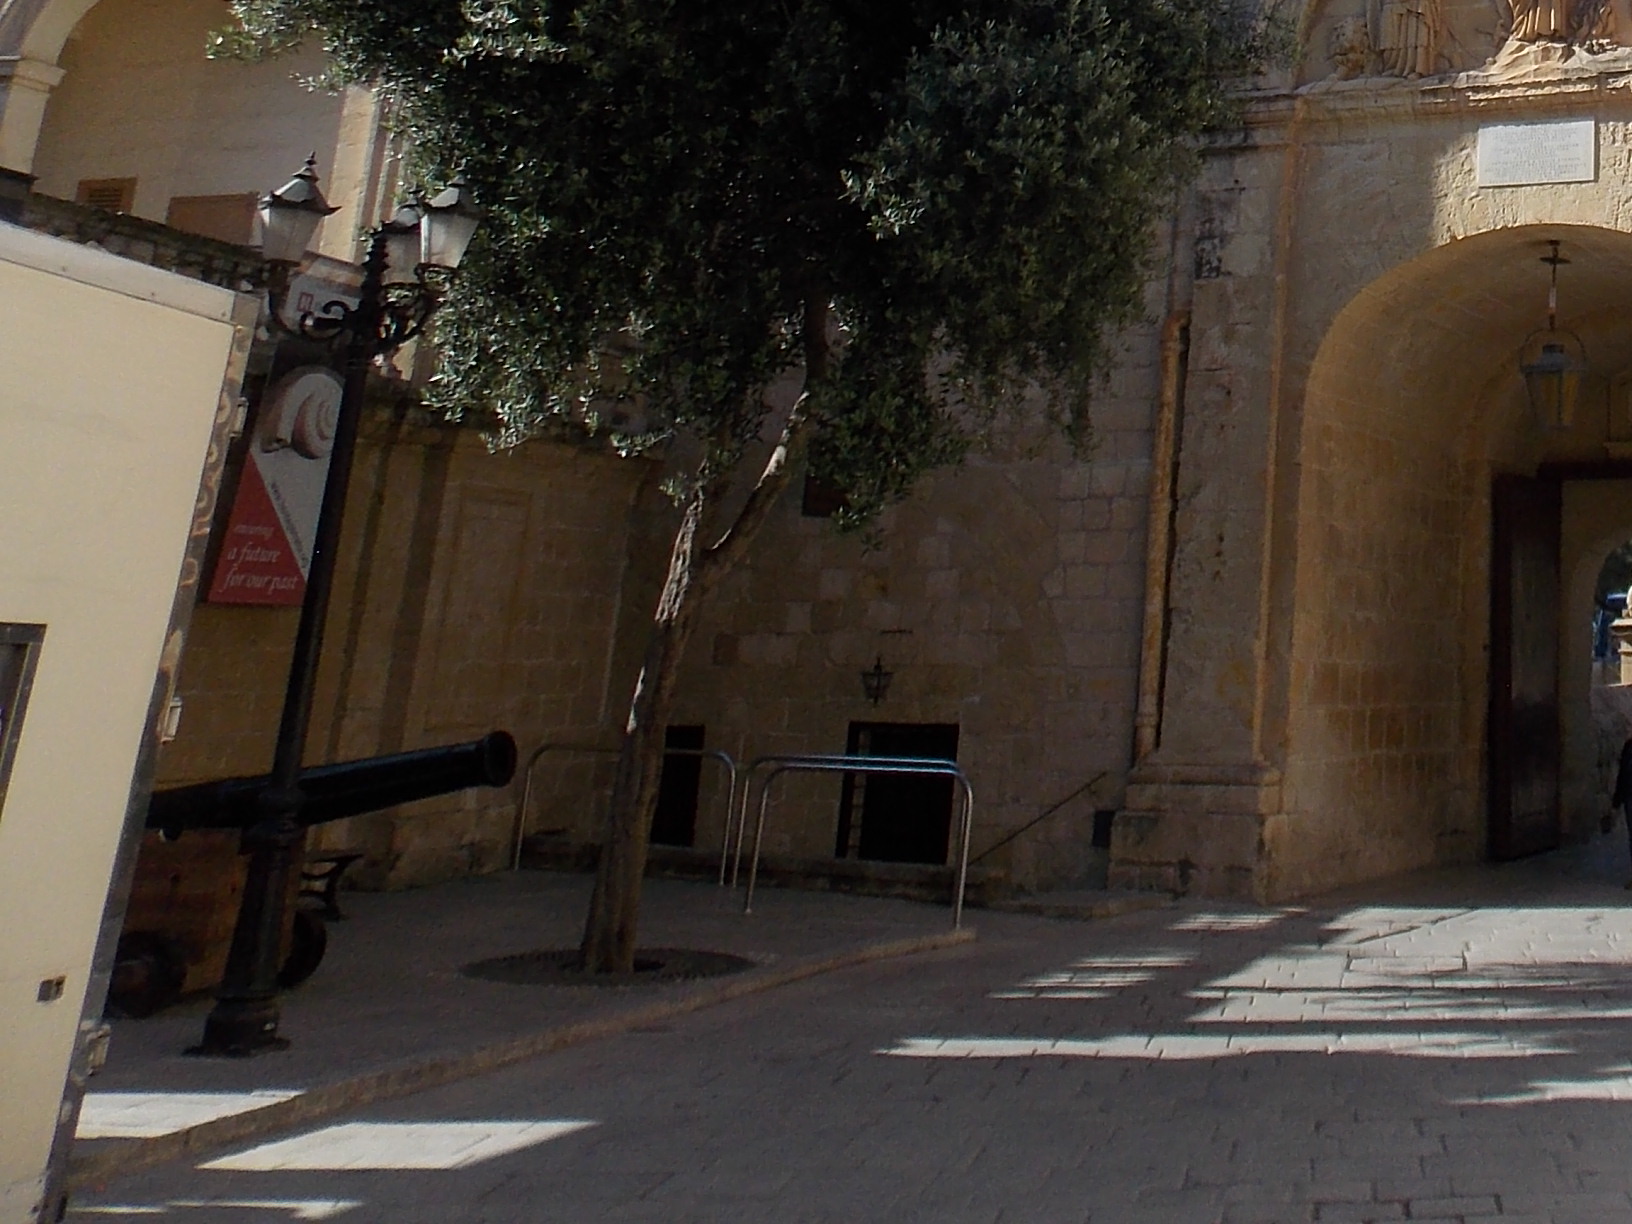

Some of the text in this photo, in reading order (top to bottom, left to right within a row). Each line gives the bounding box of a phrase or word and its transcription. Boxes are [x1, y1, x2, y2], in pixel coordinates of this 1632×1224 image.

[227, 540, 282, 566] a future
[218, 566, 298, 596] for our past
